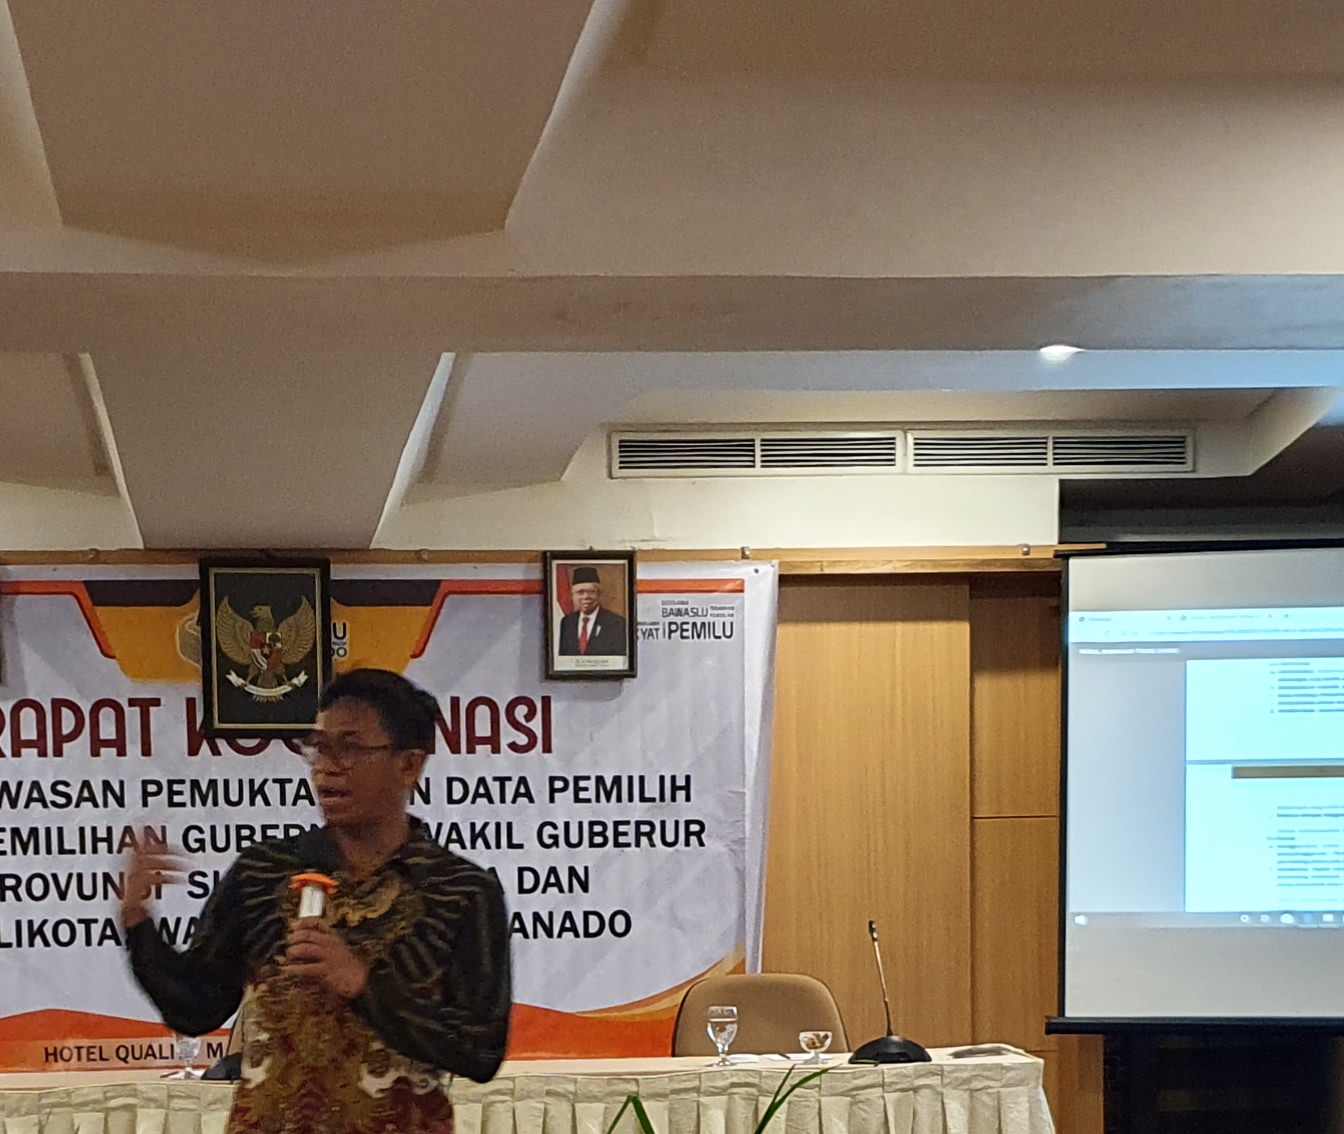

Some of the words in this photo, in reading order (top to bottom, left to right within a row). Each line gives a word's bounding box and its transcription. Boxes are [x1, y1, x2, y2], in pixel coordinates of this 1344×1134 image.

[667, 620, 734, 640] PEMILU
[446, 775, 535, 805] DATA
[548, 774, 692, 804] PEMILIH
[536, 819, 706, 849] GUBERUR
[517, 865, 590, 894] DAN
[507, 909, 633, 939] ANADO
[43, 1045, 110, 1064] HOTEL
